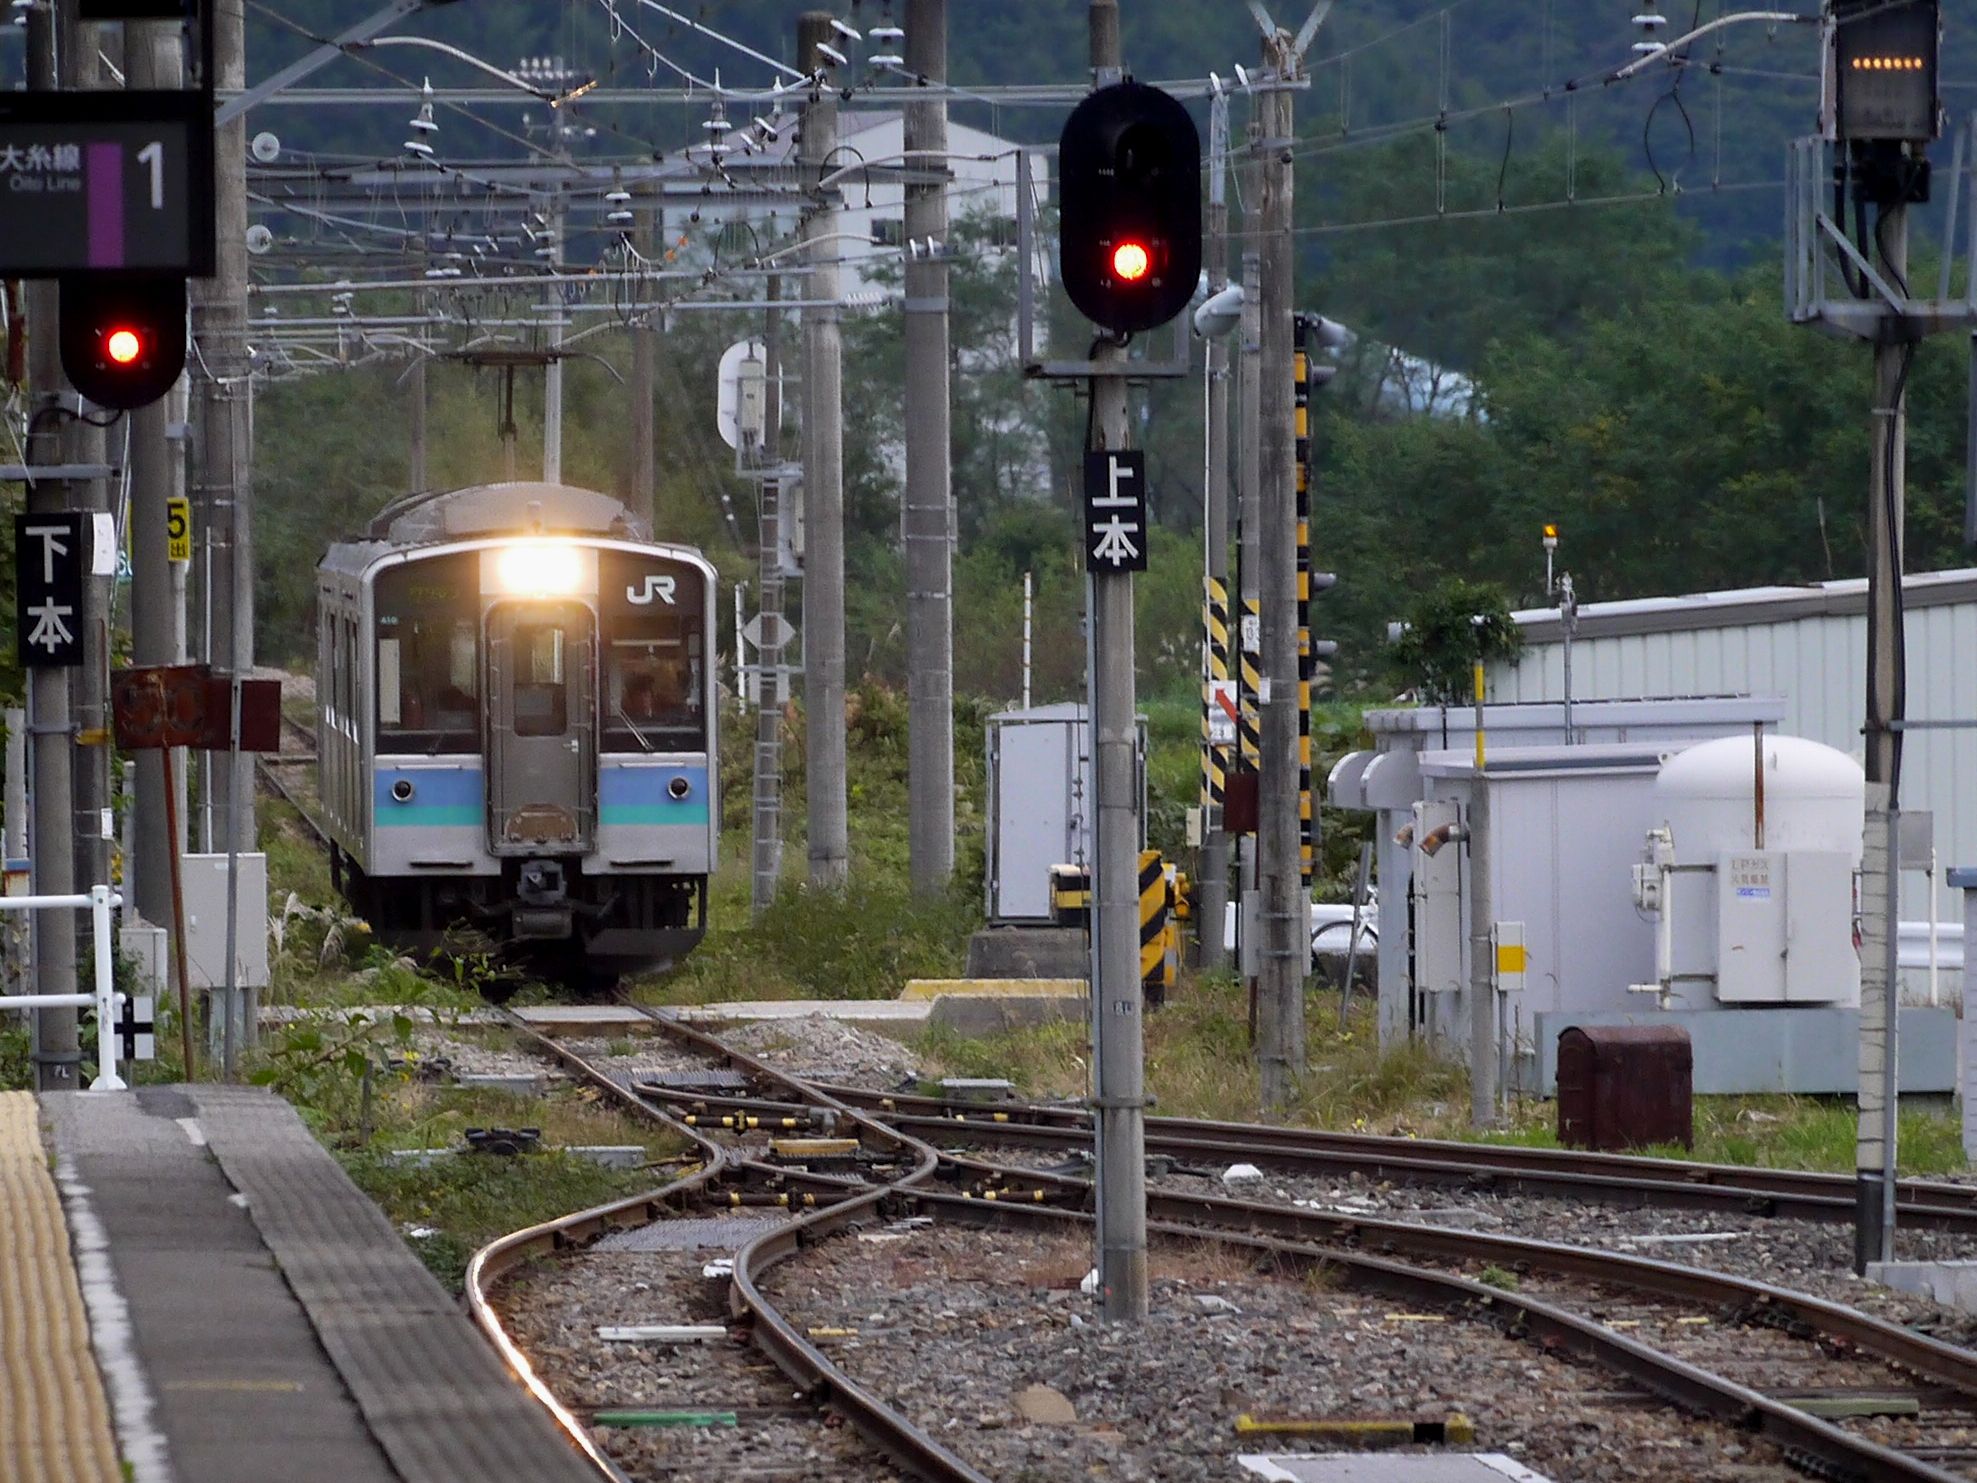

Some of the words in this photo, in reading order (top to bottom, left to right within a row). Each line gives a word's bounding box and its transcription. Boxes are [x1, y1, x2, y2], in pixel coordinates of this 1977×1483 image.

[0, 143, 80, 171] 大糸線
[137, 141, 163, 210] 1
[48, 175, 81, 191] Line
[167, 503, 186, 540] 5
[1092, 455, 1139, 566] 上本
[25, 526, 74, 654] 下本
[626, 576, 676, 605] JR
